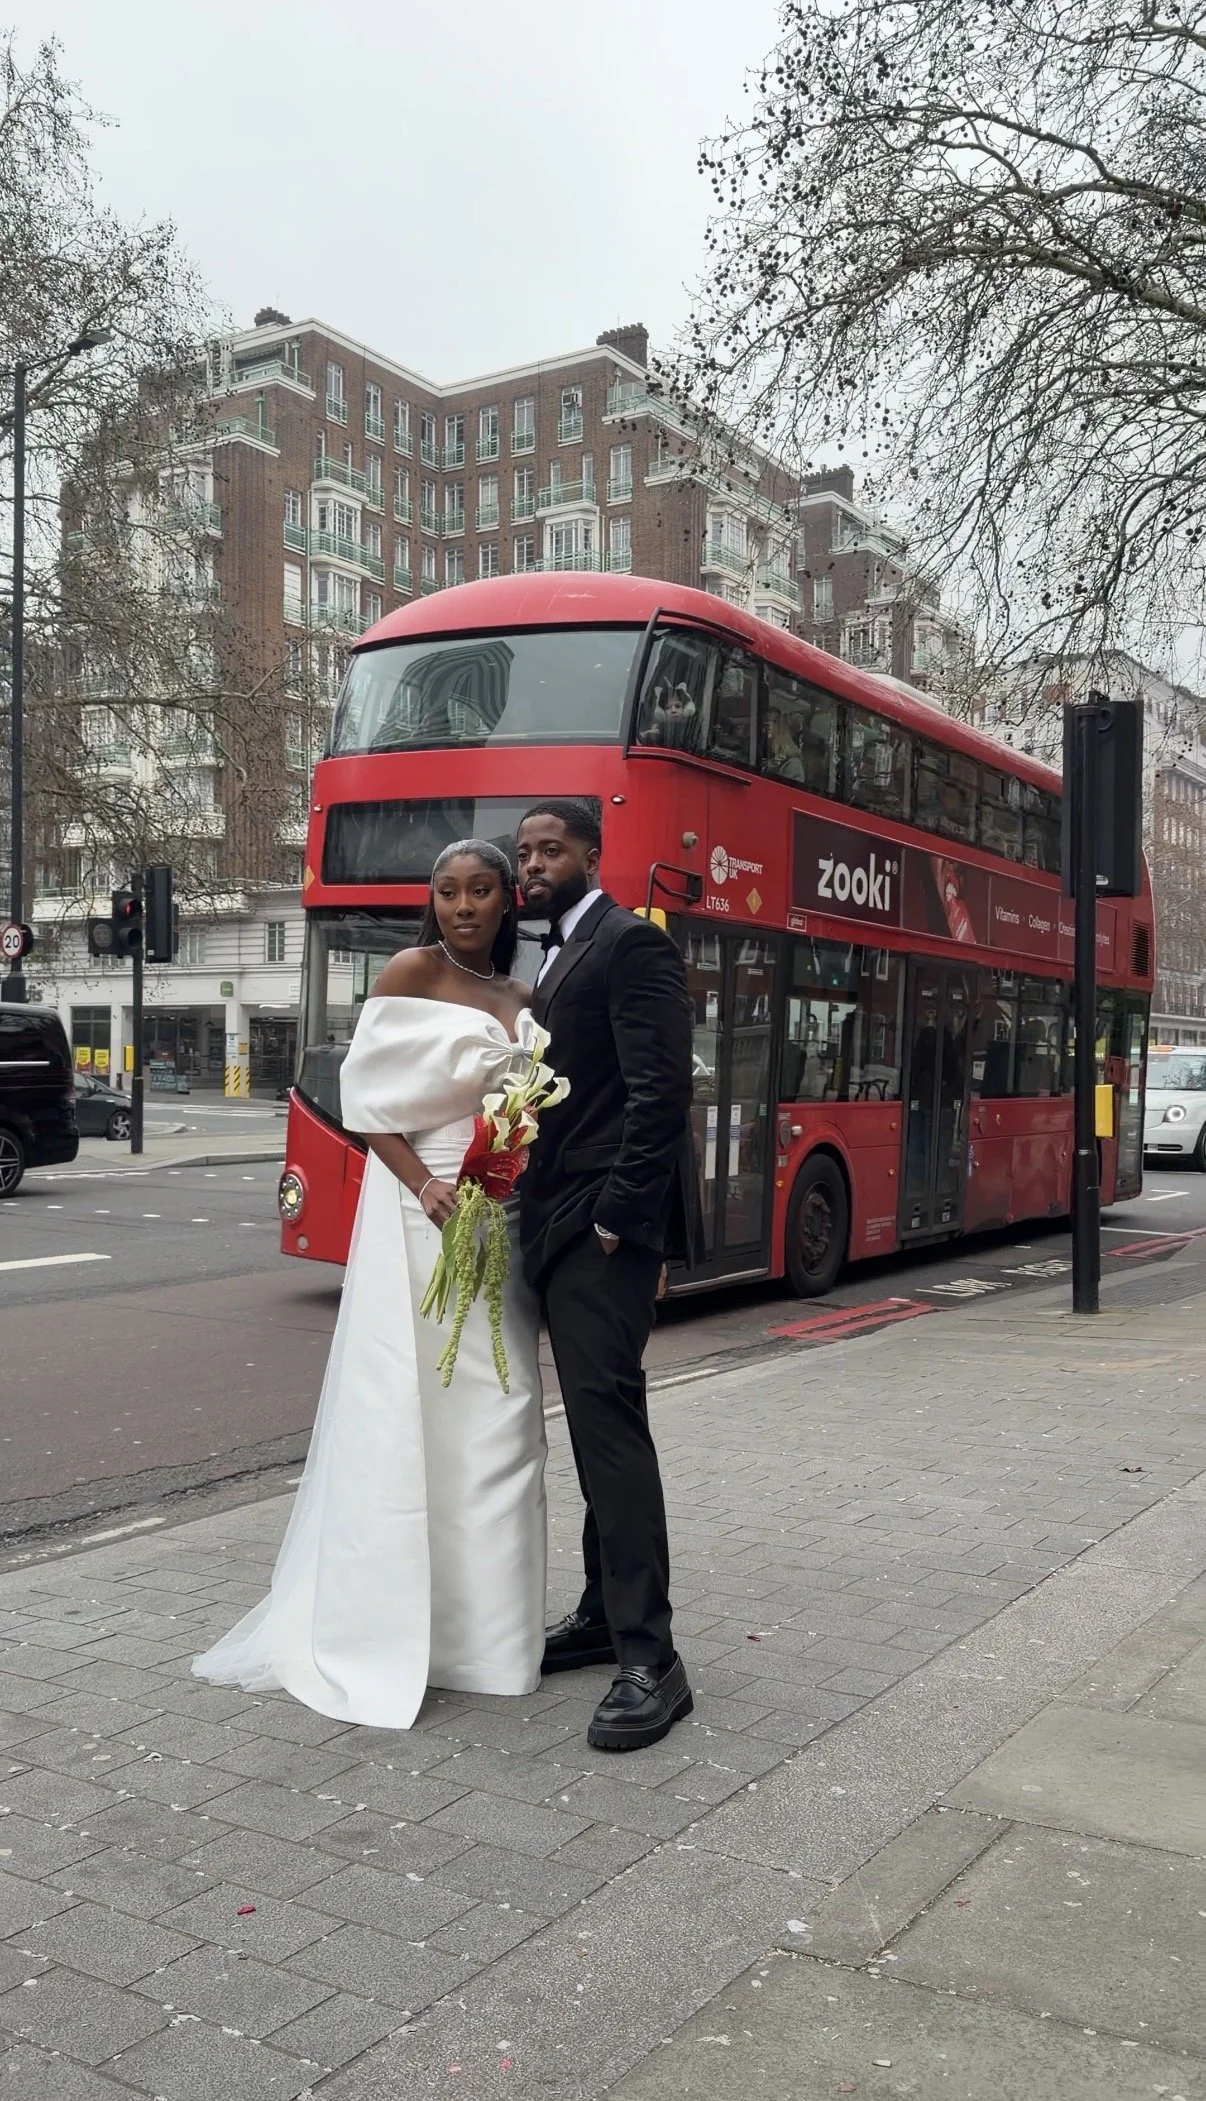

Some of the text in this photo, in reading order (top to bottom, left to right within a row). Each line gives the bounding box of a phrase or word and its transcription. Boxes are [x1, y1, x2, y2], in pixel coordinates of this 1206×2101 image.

[728, 857, 763, 875] TRANSPORT
[729, 869, 738, 880] UK
[706, 895, 730, 912] LT636
[5, 934, 20, 949] 20
